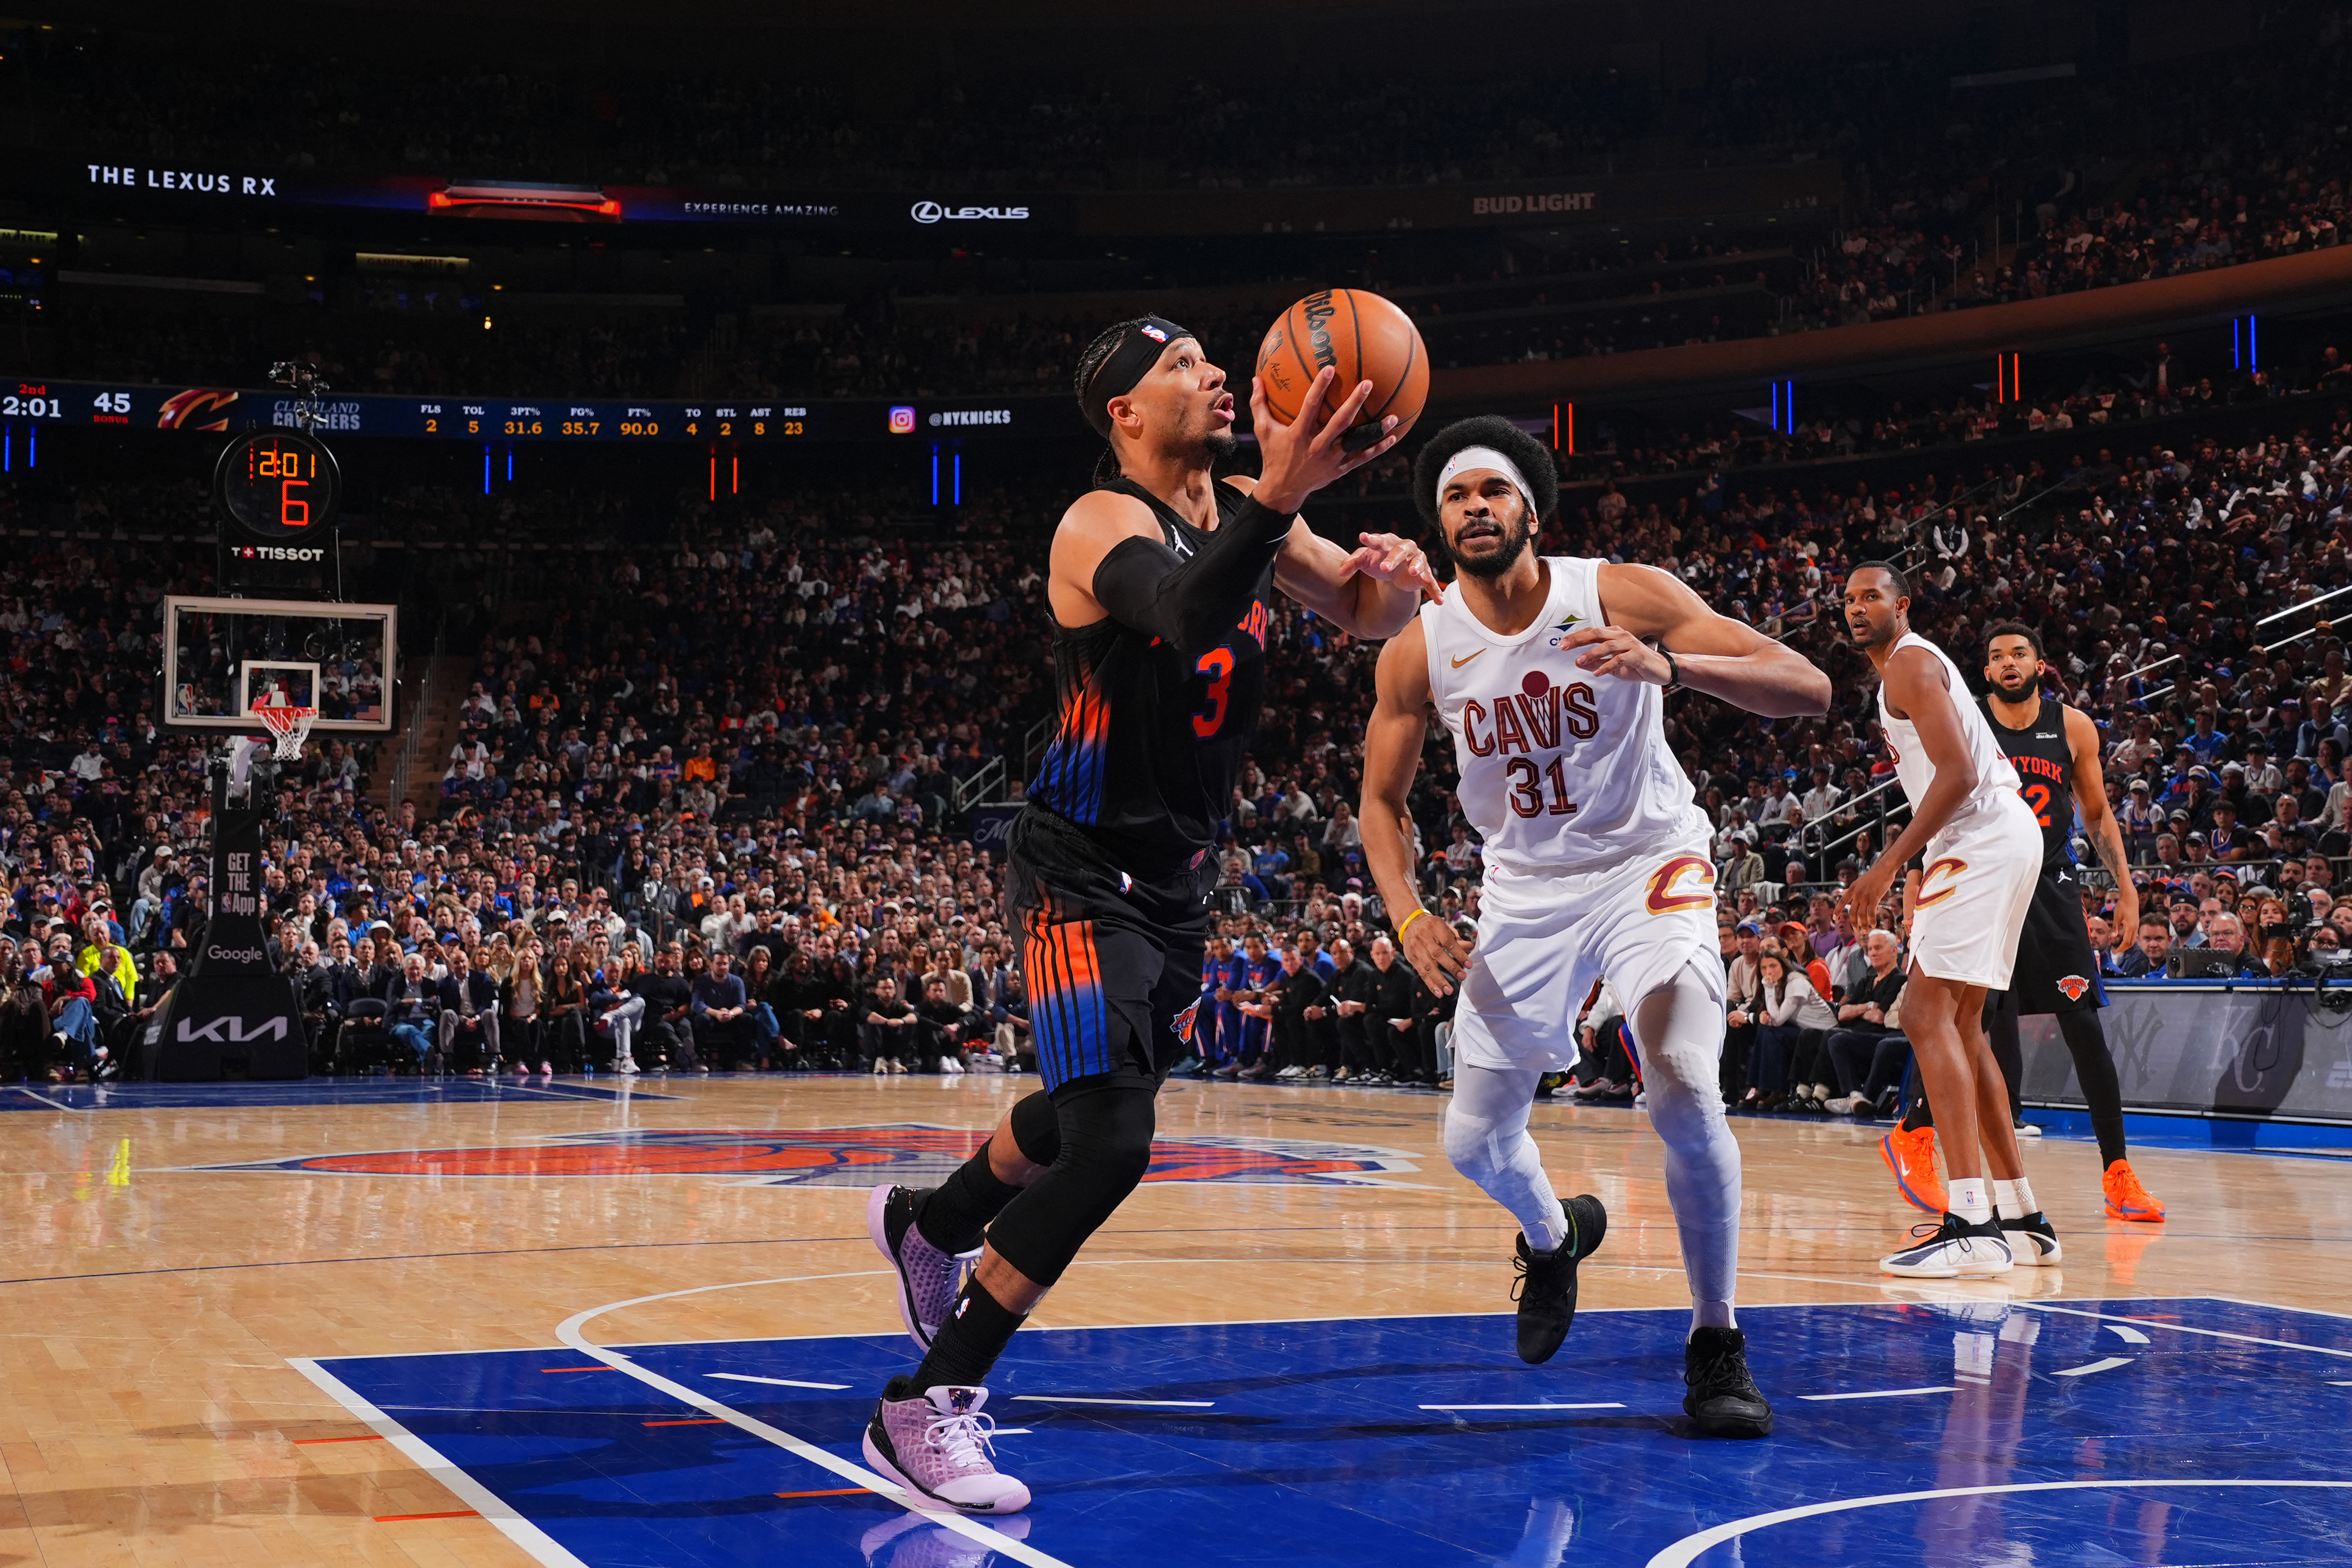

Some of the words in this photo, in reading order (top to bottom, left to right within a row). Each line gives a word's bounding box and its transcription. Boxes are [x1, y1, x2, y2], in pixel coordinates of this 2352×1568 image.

[88, 164, 135, 186] THE
[148, 169, 230, 193] LEXUS
[242, 176, 276, 196] RX
[685, 202, 768, 214] EXPERIENCE
[775, 204, 838, 216] AMAZING
[1473, 197, 1523, 214] BUD
[1525, 192, 1596, 212] LIGHT
[943, 206, 1030, 220] LEXUS
[19, 384, 46, 395] 2nd
[2, 396, 62, 418] 2:01
[93, 393, 131, 413] 45
[421, 404, 441, 414] FLS
[463, 406, 485, 415] TOL
[510, 407, 540, 416] 3PT%
[571, 408, 594, 417] FG%
[628, 408, 651, 417] FT%
[686, 409, 701, 418] TO
[716, 409, 736, 418] STL
[750, 408, 771, 417] AST
[784, 407, 806, 417] REB
[93, 415, 129, 424] BONUS
[929, 410, 1011, 427] @NYKNICKS
[426, 419, 437, 432] 2
[468, 421, 479, 433] 5
[505, 422, 542, 435] 31.6
[562, 422, 600, 435] 35.7
[620, 423, 659, 436] 90.0
[686, 424, 698, 435] 4
[720, 423, 731, 436] 2
[754, 423, 765, 435] 8
[784, 422, 803, 435] 23
[259, 451, 316, 478] 2:01
[281, 479, 309, 526] 6
[257, 547, 324, 561] TISSOT
[1191, 644, 1236, 740] 3
[1464, 682, 1600, 758] CAVS
[2019, 756, 2062, 784] YORK
[1506, 754, 1577, 819] 31
[228, 852, 250, 872] GET
[227, 873, 250, 891] THE
[232, 893, 255, 916] App
[208, 944, 263, 964] Google
